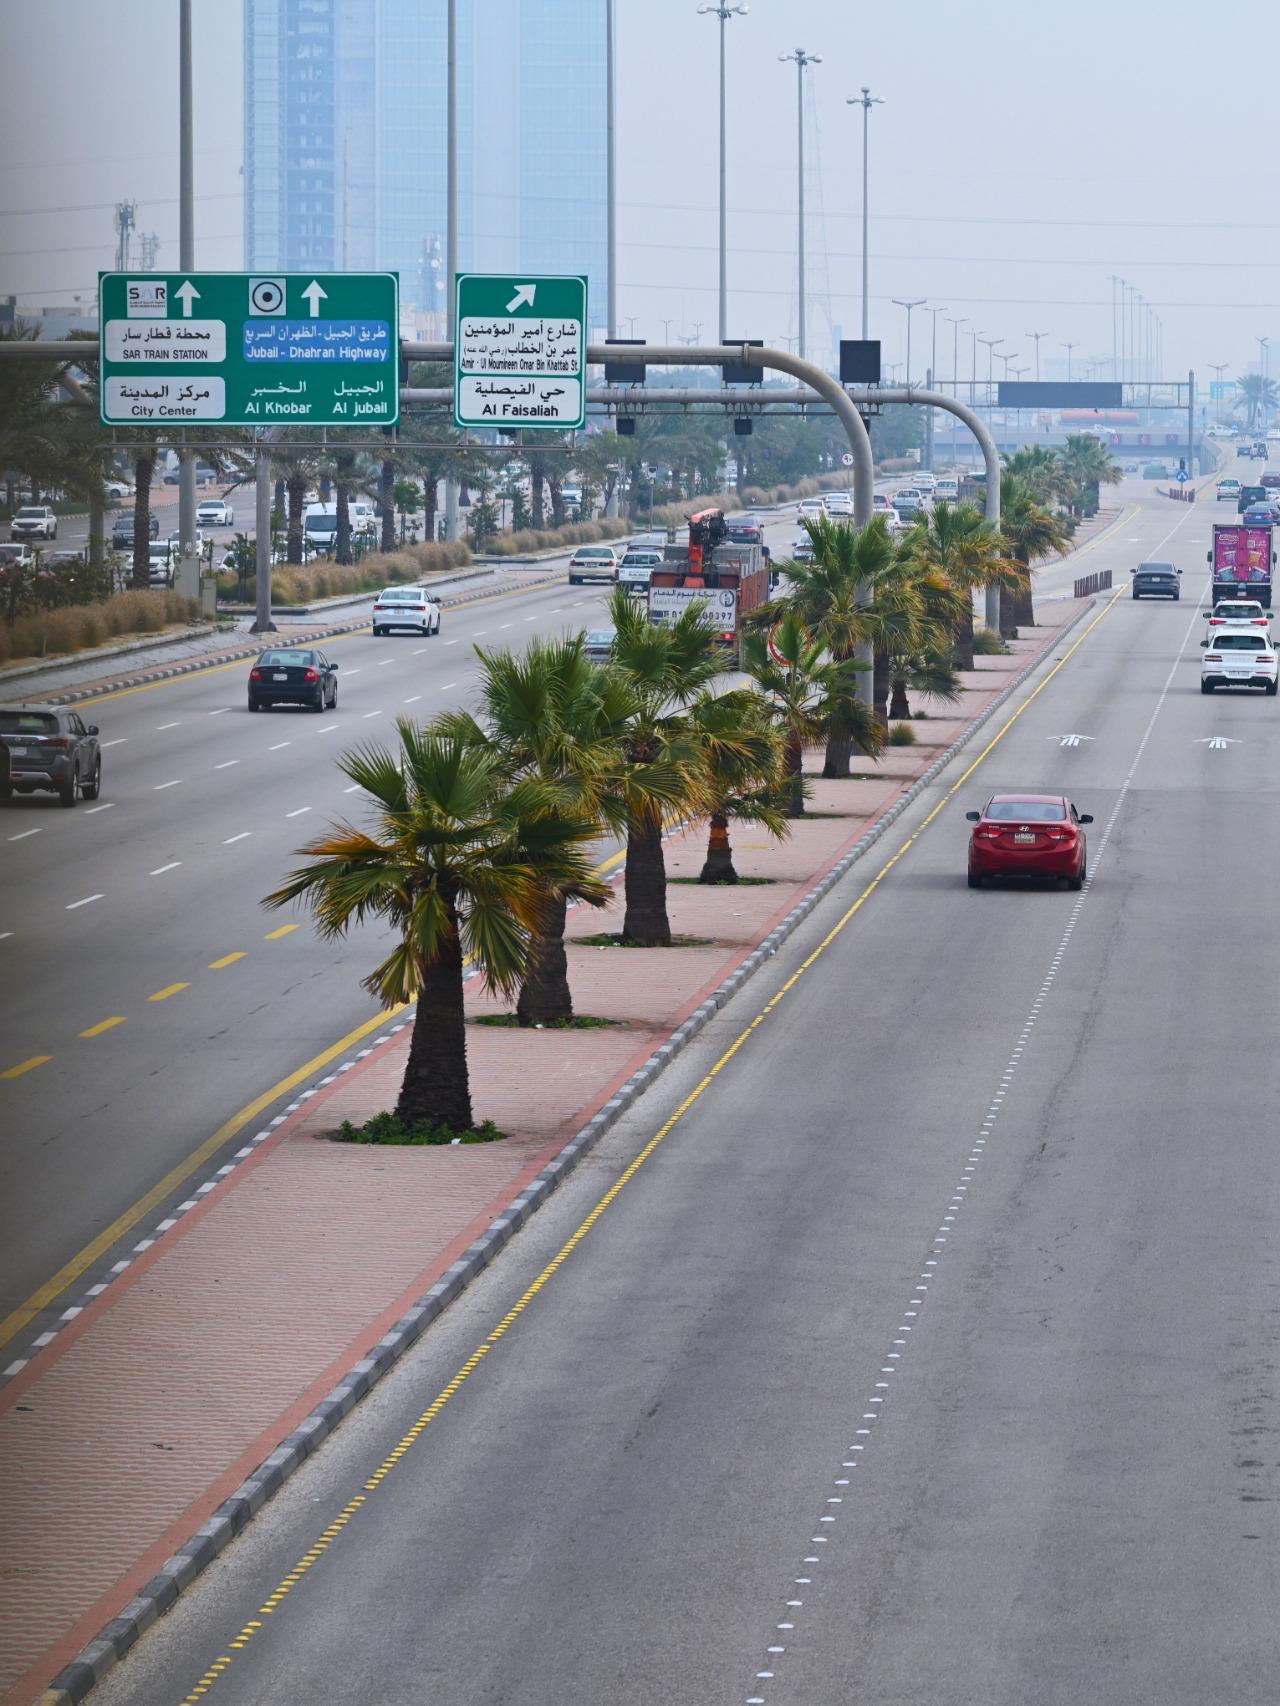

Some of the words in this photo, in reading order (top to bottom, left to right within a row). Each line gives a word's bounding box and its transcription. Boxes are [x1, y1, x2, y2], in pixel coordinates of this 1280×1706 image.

[122, 327, 141, 342] سار
[144, 326, 172, 342] قطار
[175, 327, 211, 340] محطة
[245, 325, 276, 343] السريع
[278, 325, 317, 341] الظهران
[324, 325, 356, 341] الجبيل
[358, 325, 386, 342] طريق
[464, 323, 514, 337] المؤمنين
[520, 320, 543, 338] أمير
[546, 323, 576, 342] شارع
[122, 350, 141, 360] SAR
[144, 350, 170, 360] TRAIN
[172, 350, 208, 360] STATION
[246, 346, 278, 359] Jubail
[289, 346, 335, 359] Dhahran
[339, 347, 387, 361] Highway
[545, 345, 557, 358] بن
[560, 346, 577, 358] عمر
[462, 357, 475, 369] Amir
[120, 385, 169, 401] المدينة
[176, 385, 210, 401] مركز
[250, 380, 307, 396] الخبر
[333, 380, 384, 397] الجبيل
[475, 382, 535, 399] الفيصلية
[540, 388, 566, 402] حي
[131, 405, 154, 417] City
[158, 405, 197, 416] Center
[245, 402, 259, 414] Al
[265, 402, 312, 414] Khobar
[332, 402, 347, 414] Al
[482, 404, 497, 416] Al
[502, 404, 559, 417] Faisaliah
